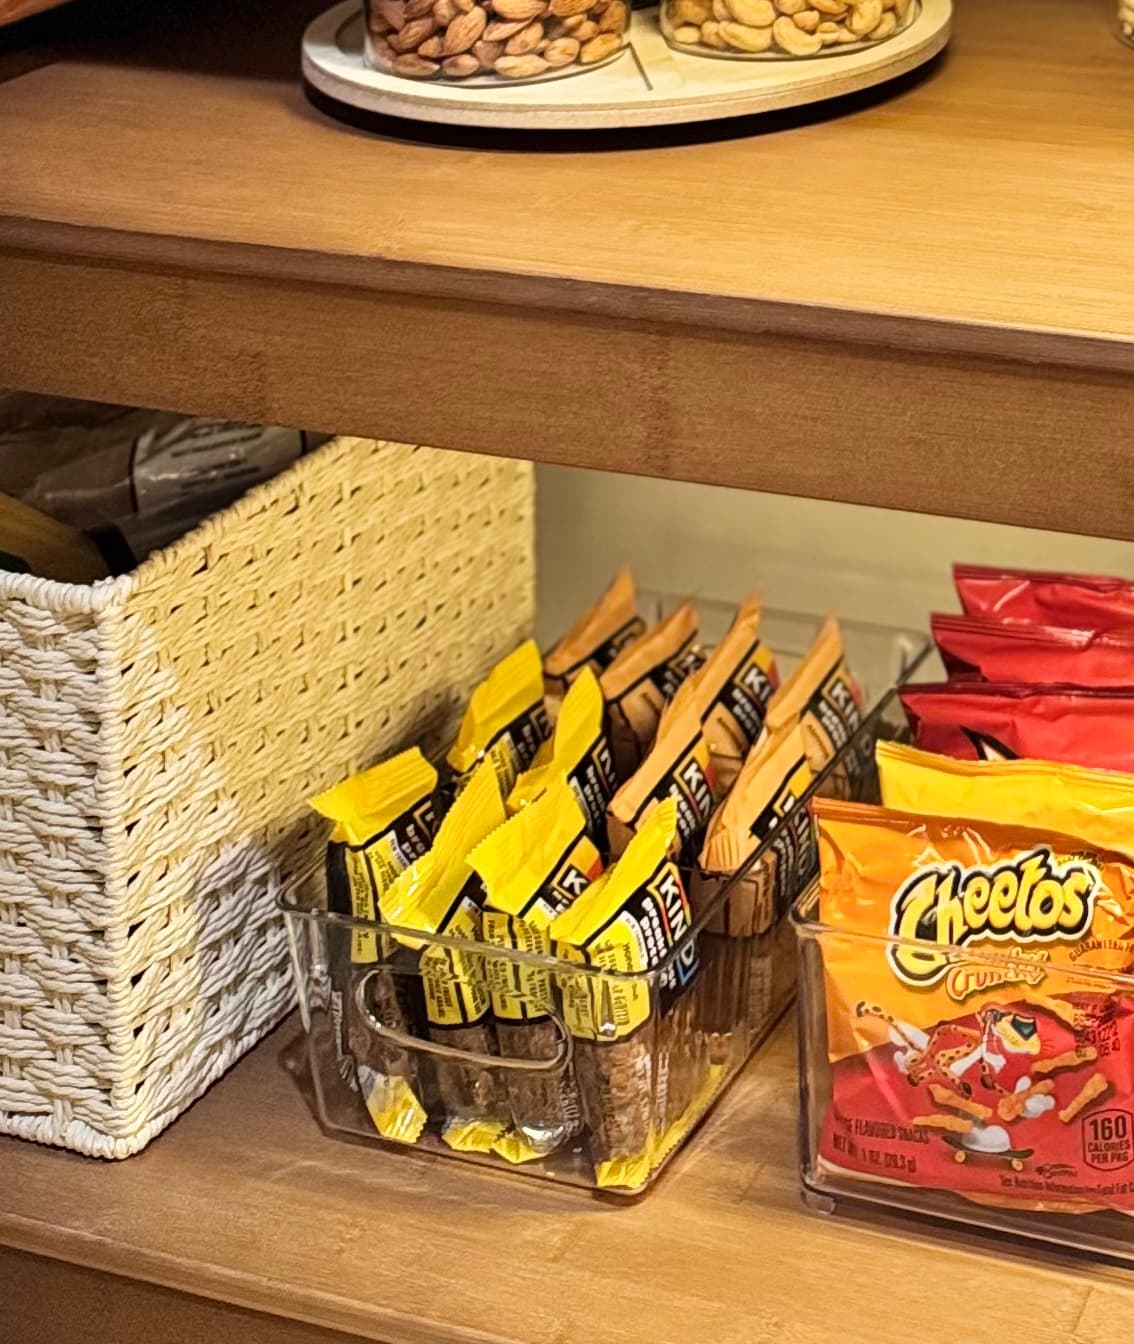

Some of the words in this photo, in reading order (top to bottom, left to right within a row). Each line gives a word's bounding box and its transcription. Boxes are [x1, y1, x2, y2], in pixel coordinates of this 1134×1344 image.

[891, 849, 1098, 981] Cheetos
[1089, 1114, 1127, 1142] 160
[1087, 1140, 1131, 1154] CALORIES
[1090, 1151, 1109, 1164] PER
[1110, 1150, 1129, 1163] PKG
